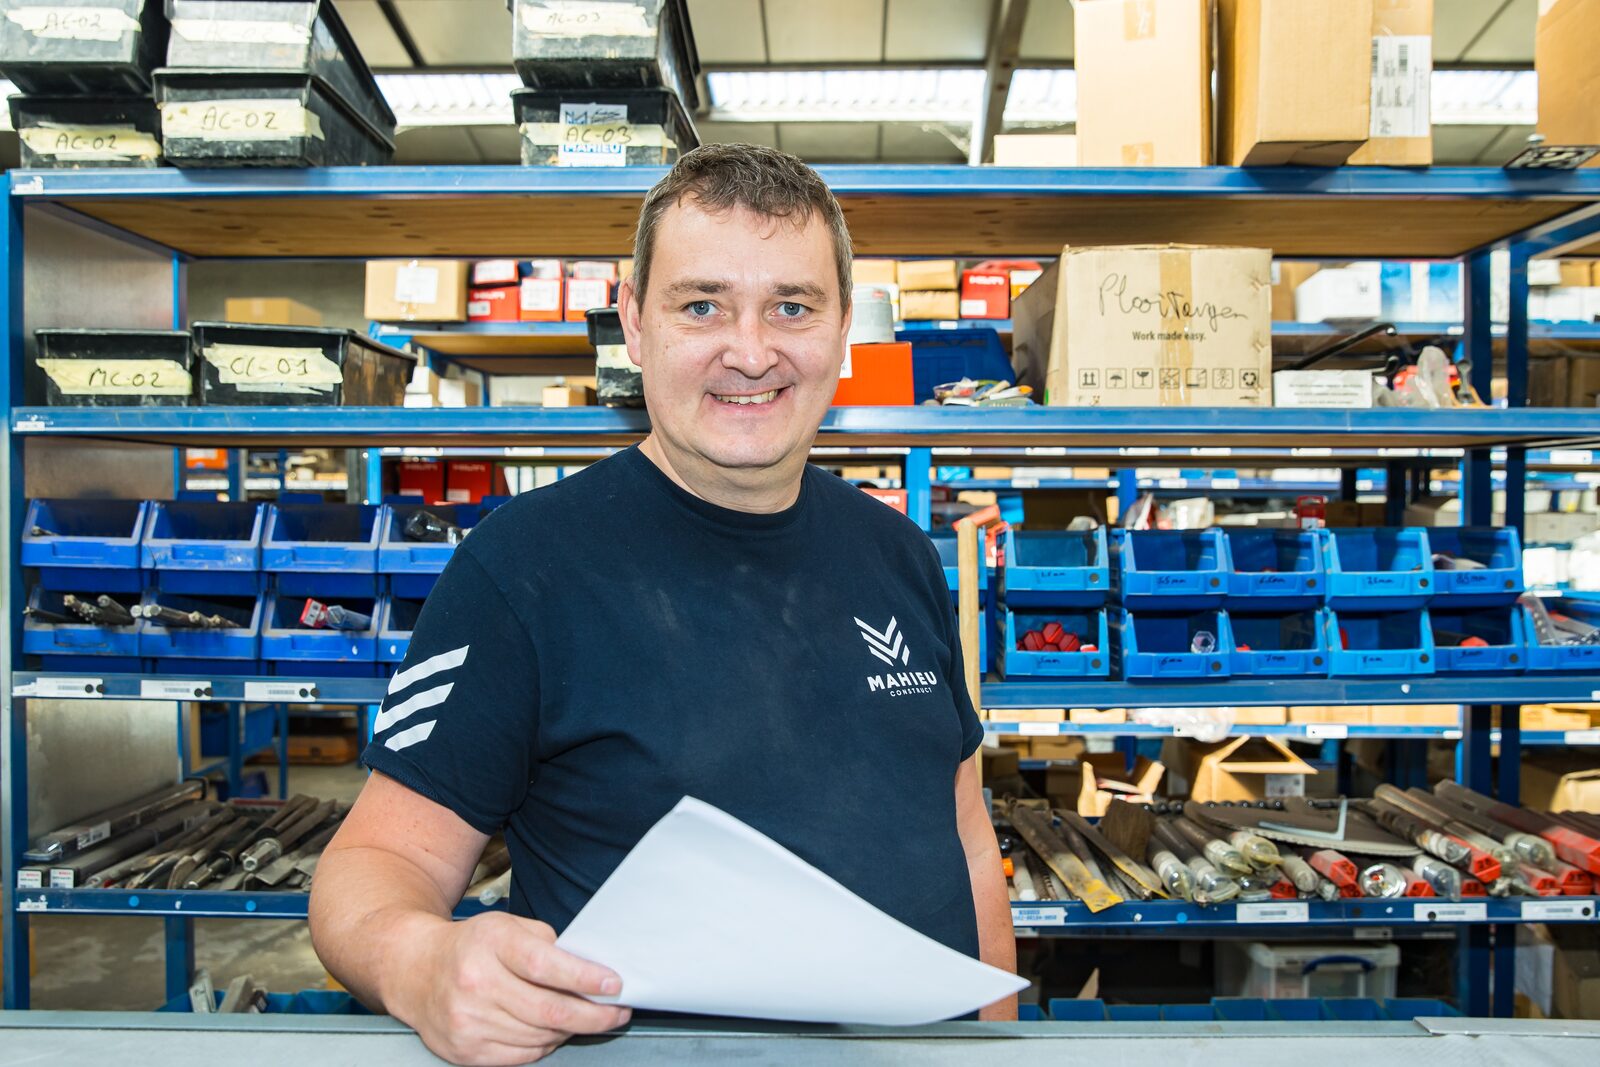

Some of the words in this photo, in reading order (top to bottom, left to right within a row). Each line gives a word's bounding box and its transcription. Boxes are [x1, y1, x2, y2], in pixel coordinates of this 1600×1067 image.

[201, 106, 279, 131] AC-02
[55, 132, 117, 150] AC-02
[565, 126, 632, 144] AC-03
[1132, 331, 1155, 341] Work
[1157, 331, 1182, 341] made
[1184, 333, 1207, 342] easy.
[88, 367, 165, 388] MC-02
[866, 670, 938, 692] MAHIEU
[889, 687, 932, 697] CONSTRUCT
